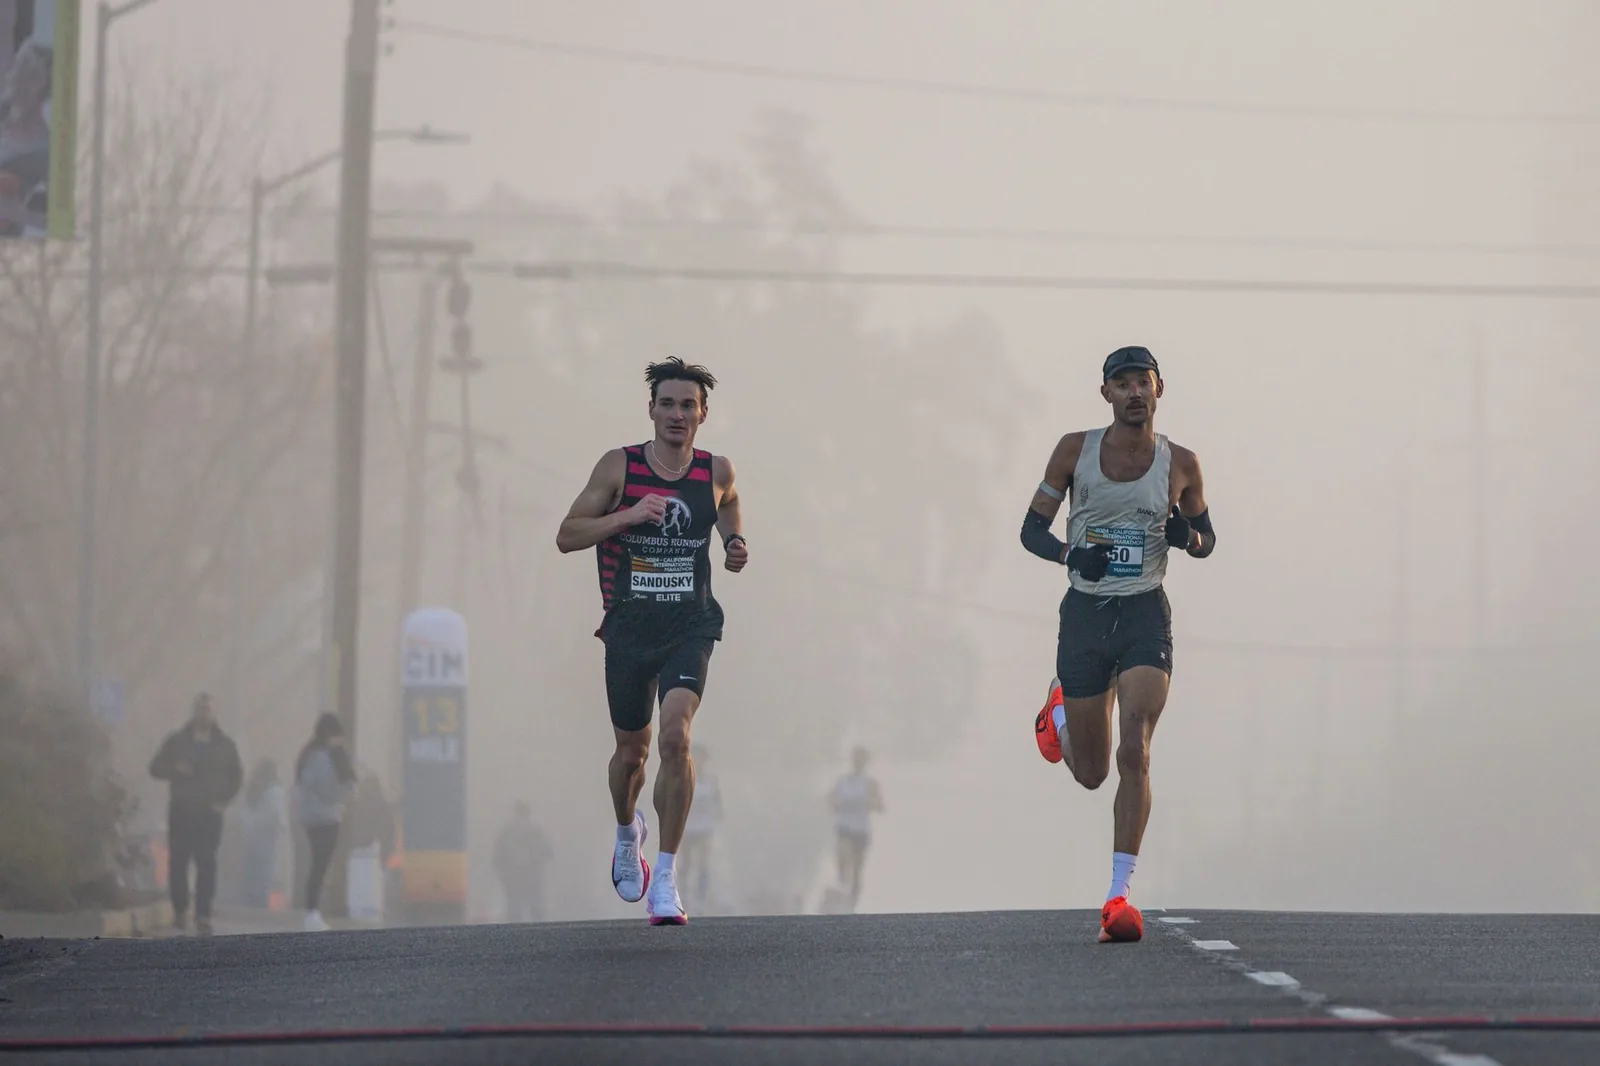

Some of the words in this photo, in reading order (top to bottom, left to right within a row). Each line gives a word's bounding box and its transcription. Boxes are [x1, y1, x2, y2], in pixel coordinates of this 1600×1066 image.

[620, 534, 669, 546] COLUMBUS
[642, 546, 686, 555] COMPANY
[632, 575, 693, 588] SANDUSKY
[656, 593, 682, 602] ELITE
[406, 649, 463, 679] CIM
[412, 697, 458, 734] 13
